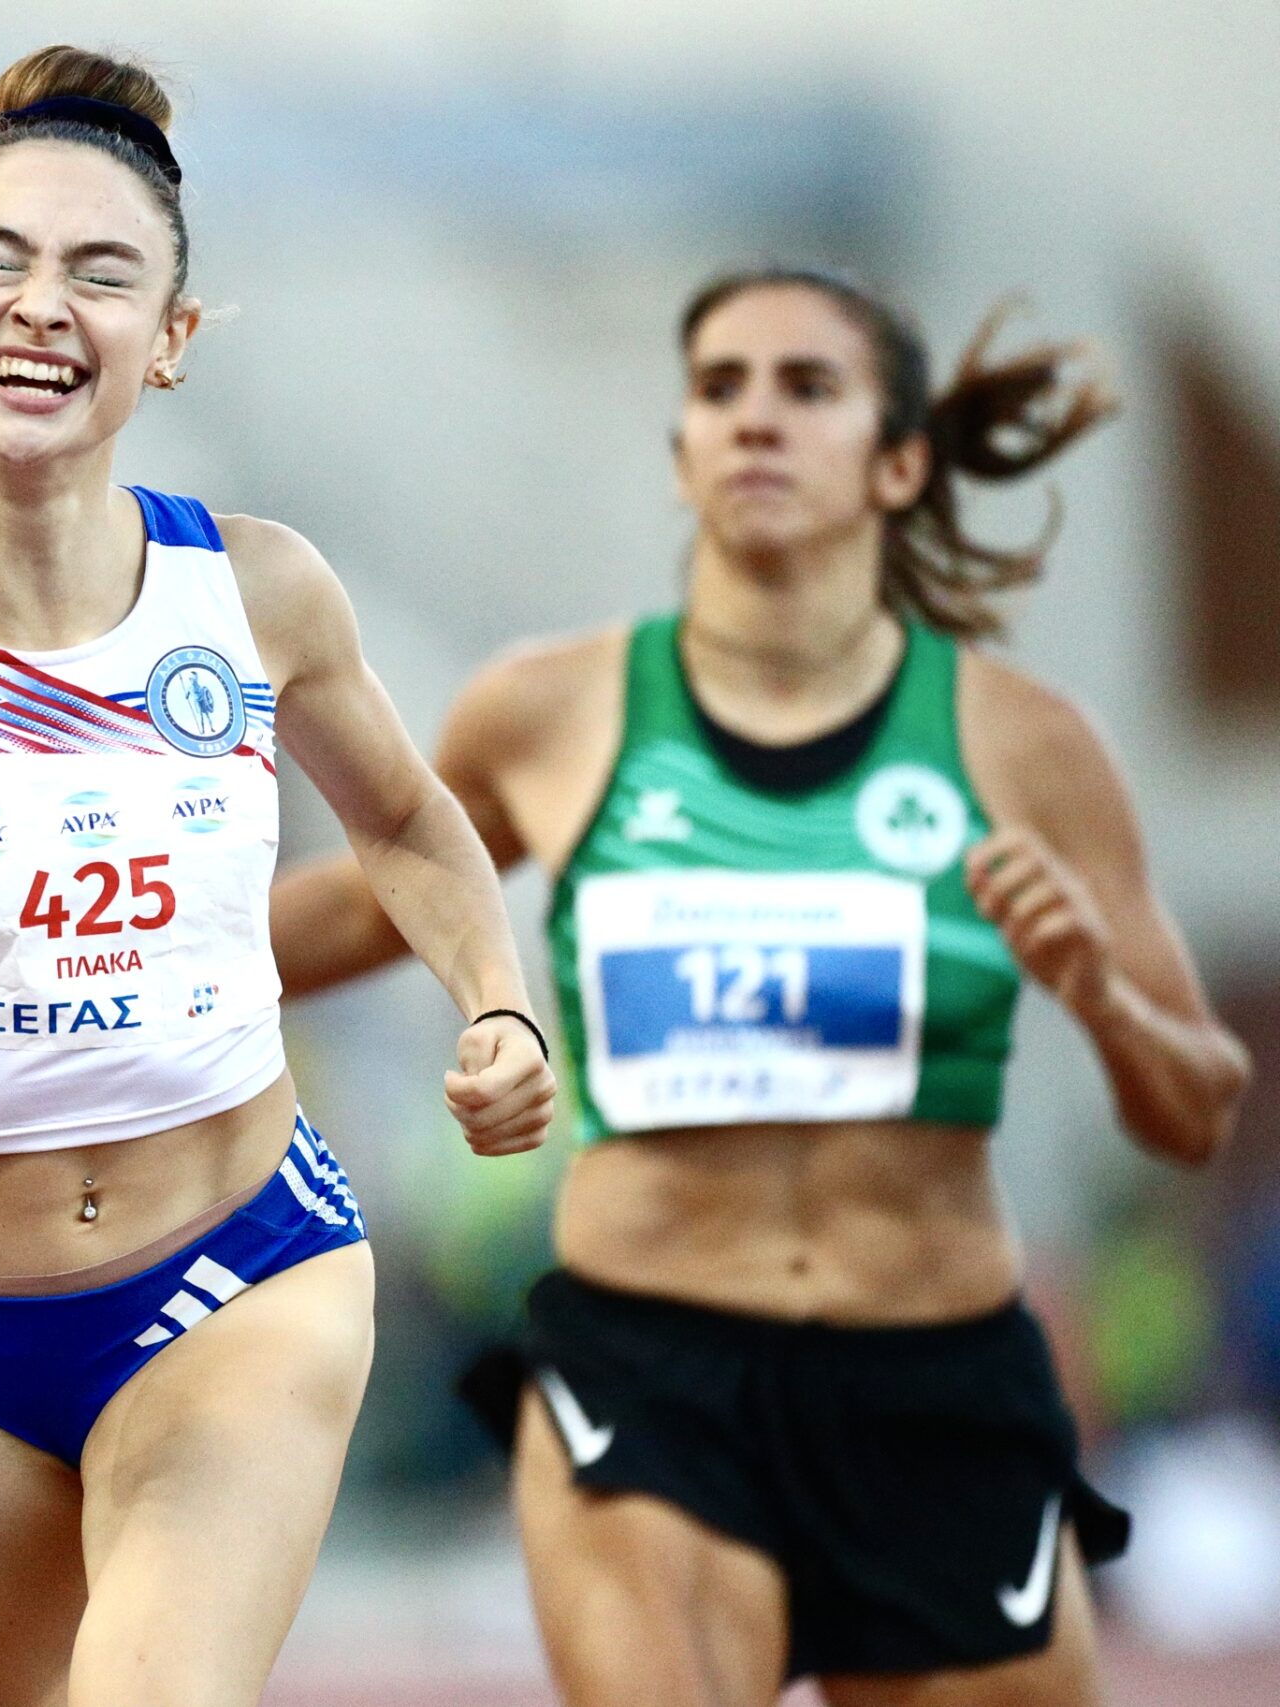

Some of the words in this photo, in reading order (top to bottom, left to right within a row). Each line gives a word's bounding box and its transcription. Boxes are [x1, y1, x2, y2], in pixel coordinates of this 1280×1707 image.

[61, 811, 119, 834] ΑΥΡΑ
[172, 797, 228, 819] ΑΥΡΑ
[20, 854, 176, 939] 425
[56, 949, 143, 979] ΠΛΑΚΑ
[675, 948, 809, 1023] 121
